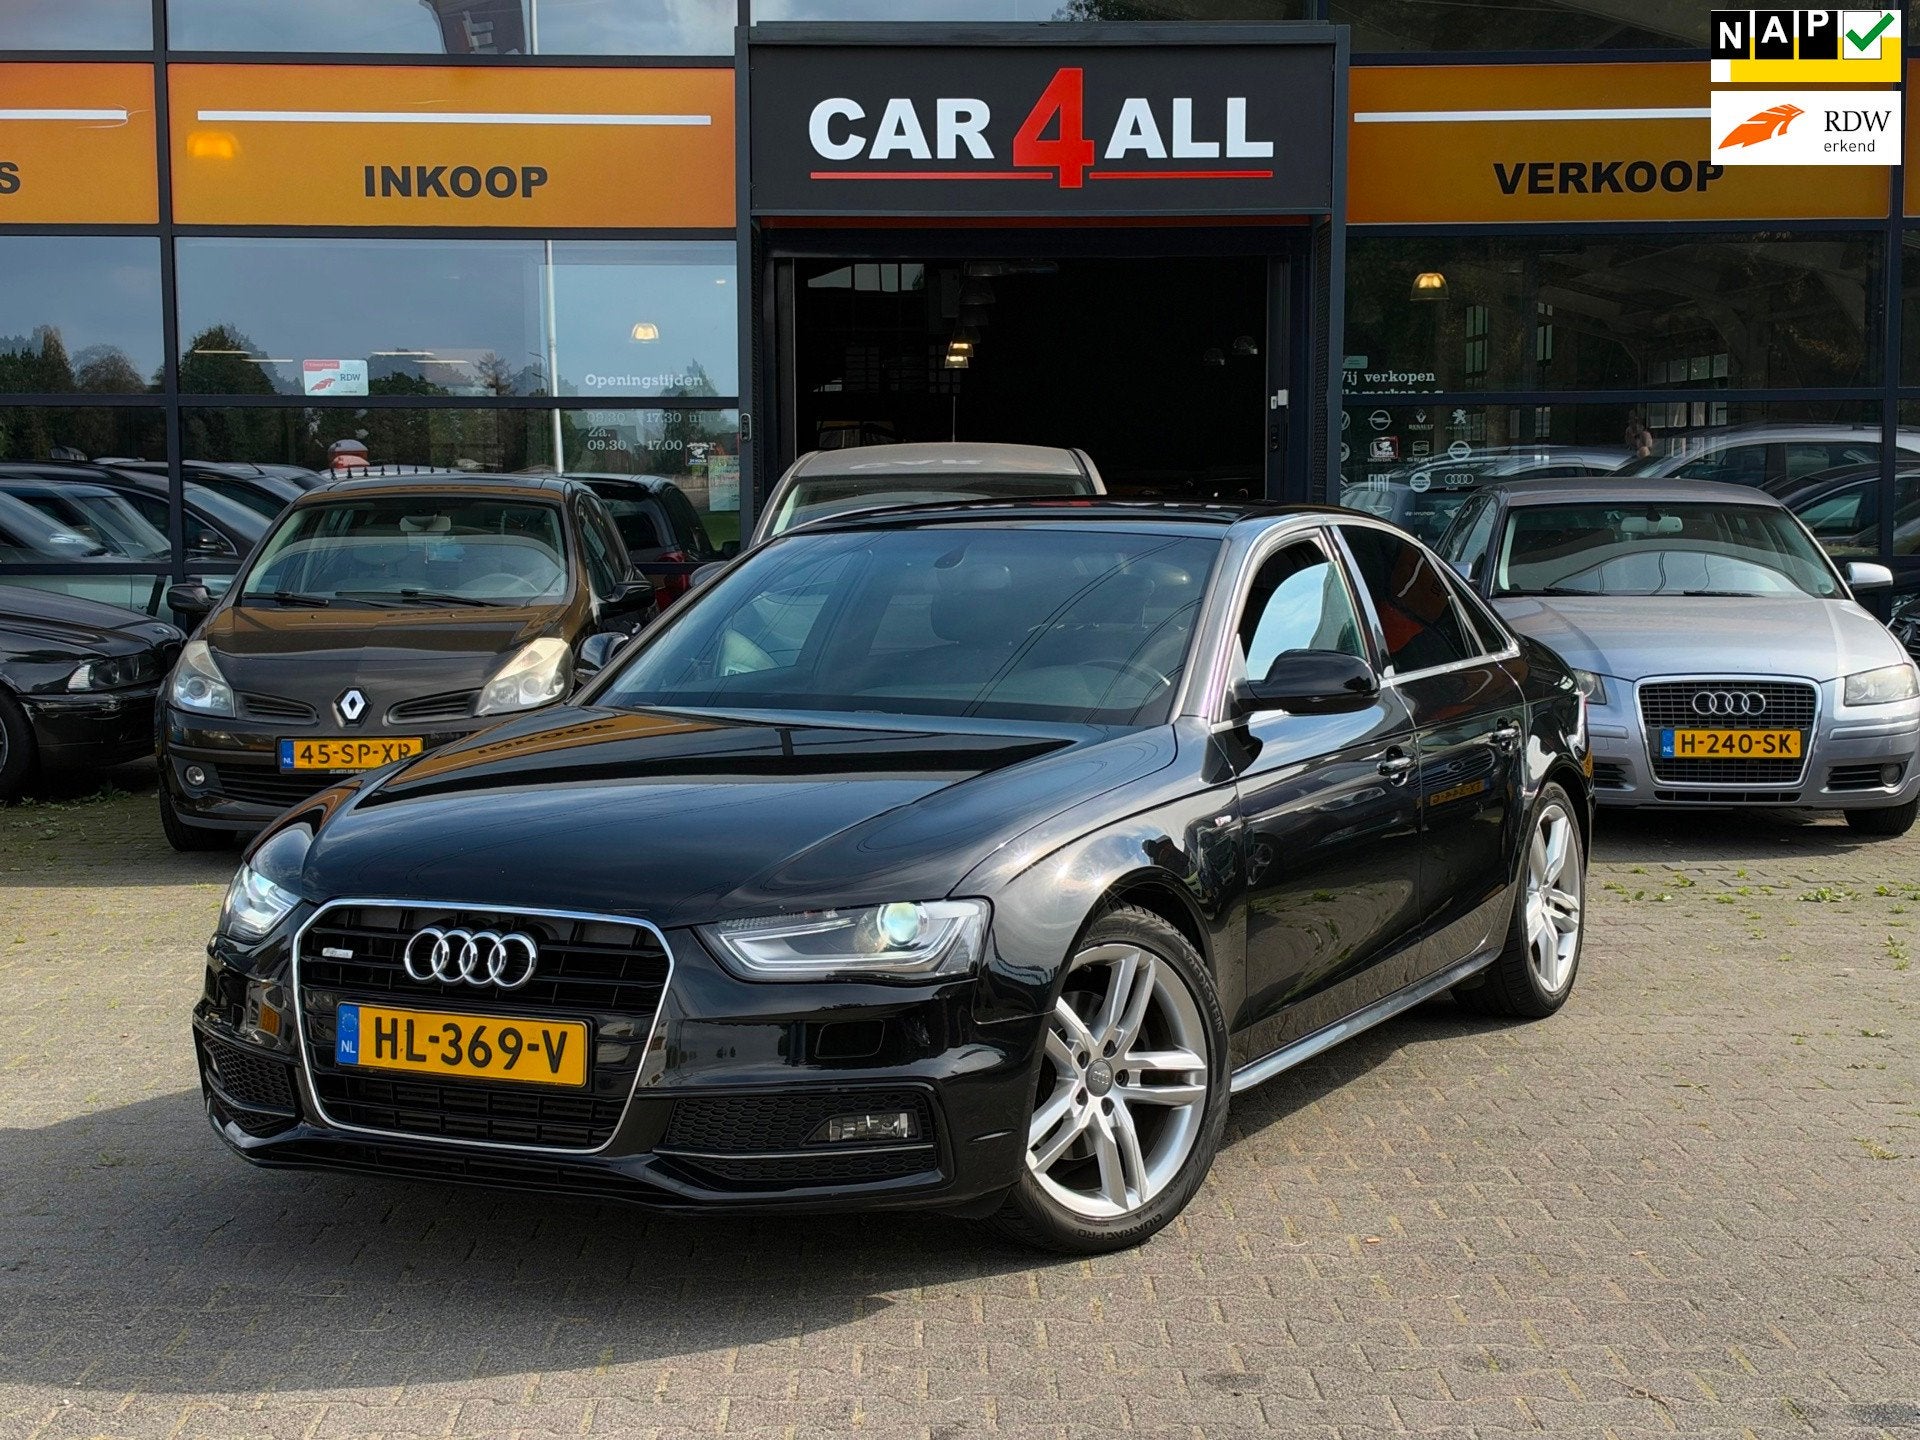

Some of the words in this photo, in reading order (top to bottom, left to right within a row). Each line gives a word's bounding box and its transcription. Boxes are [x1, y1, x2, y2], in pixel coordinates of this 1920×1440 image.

[808, 97, 995, 160] CAR
[1013, 67, 1094, 188] 4
[1104, 97, 1274, 158] ALL
[364, 165, 548, 198] INKOOP
[1493, 160, 1724, 194] VERKOOP
[340, 373, 361, 382] RDW
[585, 374, 703, 388] Openingstijden
[1364, 370, 1436, 385] verkopen
[588, 425, 611, 437] Za.
[587, 439, 627, 450] 09.30
[648, 440, 683, 451] 17.00
[1368, 473, 1391, 491] FIAT
[1681, 733, 1792, 754] H-240-SK
[300, 743, 411, 765] 45-SP-XR
[341, 1039, 356, 1054] NL
[374, 1016, 568, 1074] HL-369-V
